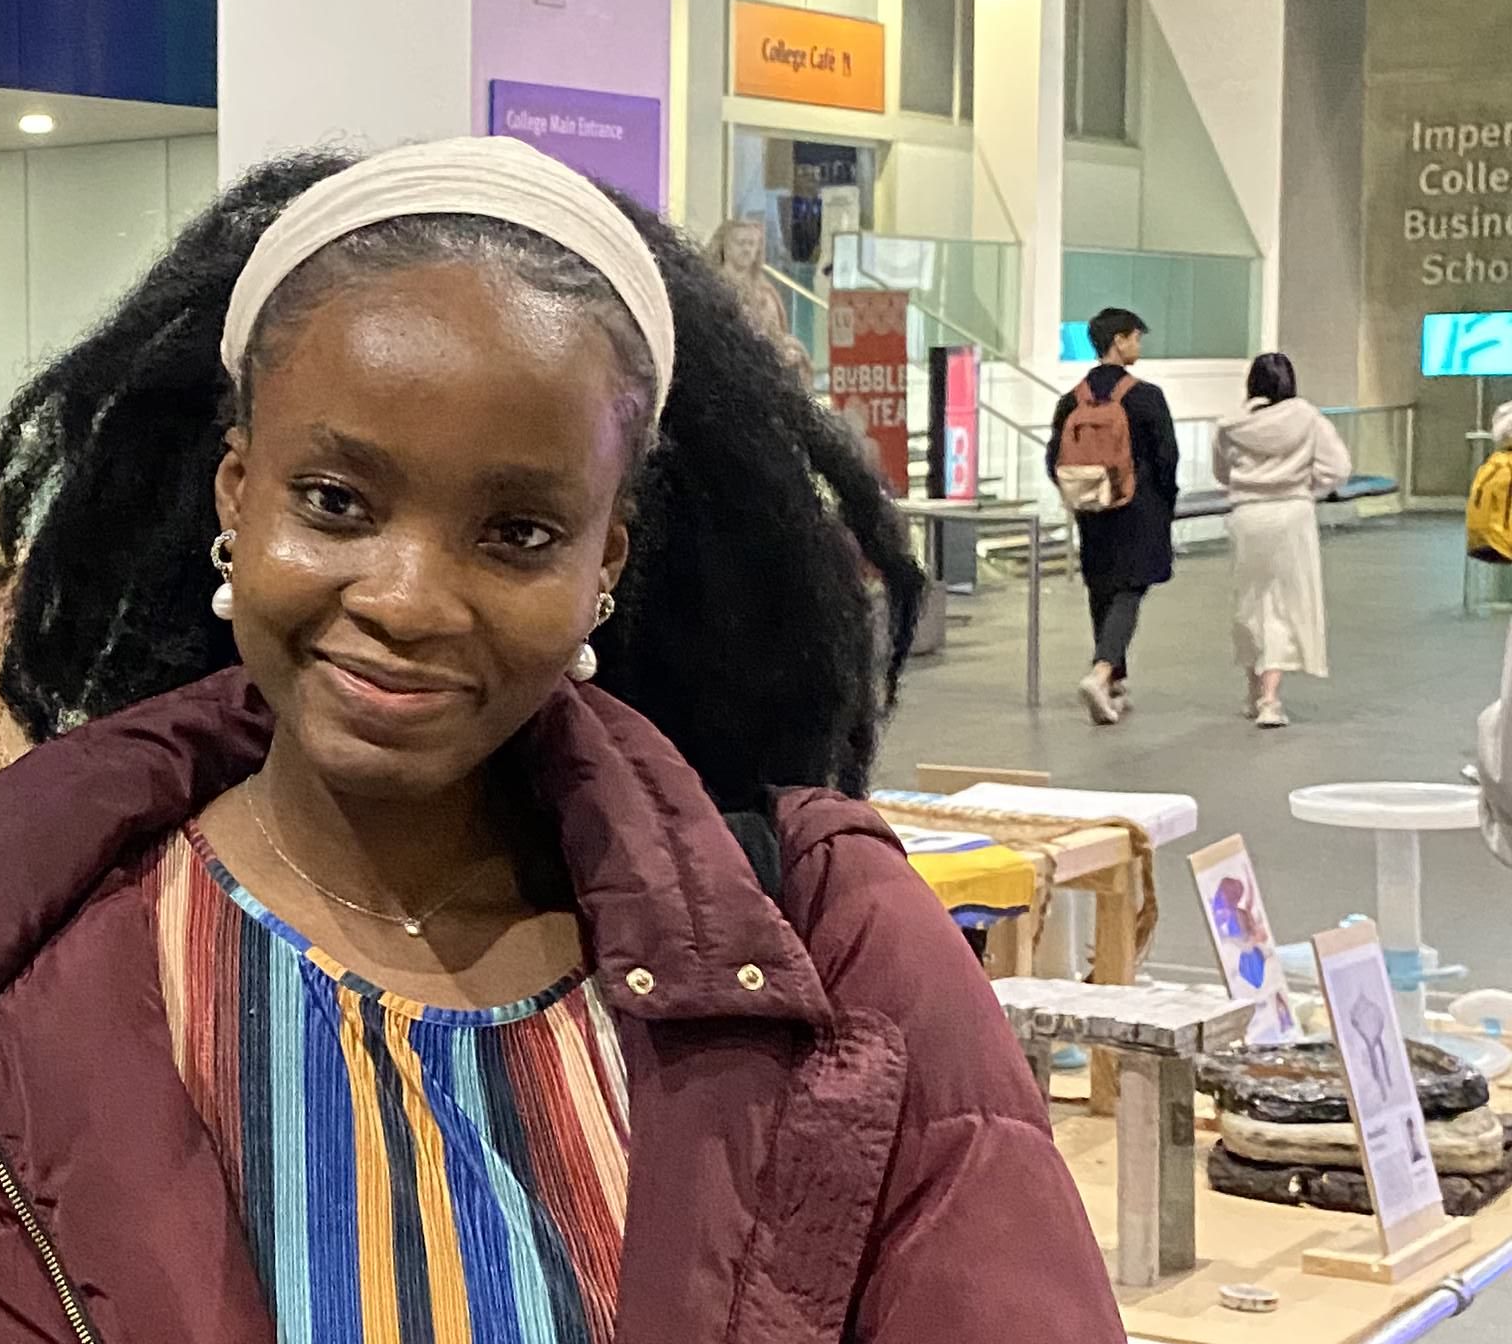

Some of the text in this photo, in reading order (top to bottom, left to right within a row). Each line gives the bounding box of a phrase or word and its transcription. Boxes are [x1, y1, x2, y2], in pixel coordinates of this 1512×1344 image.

[761, 37, 807, 72] College
[506, 110, 624, 140] College Main Entrance
[1419, 160, 1512, 195] Colle
[1422, 252, 1512, 285] Scho
[869, 397, 906, 427] TEA
